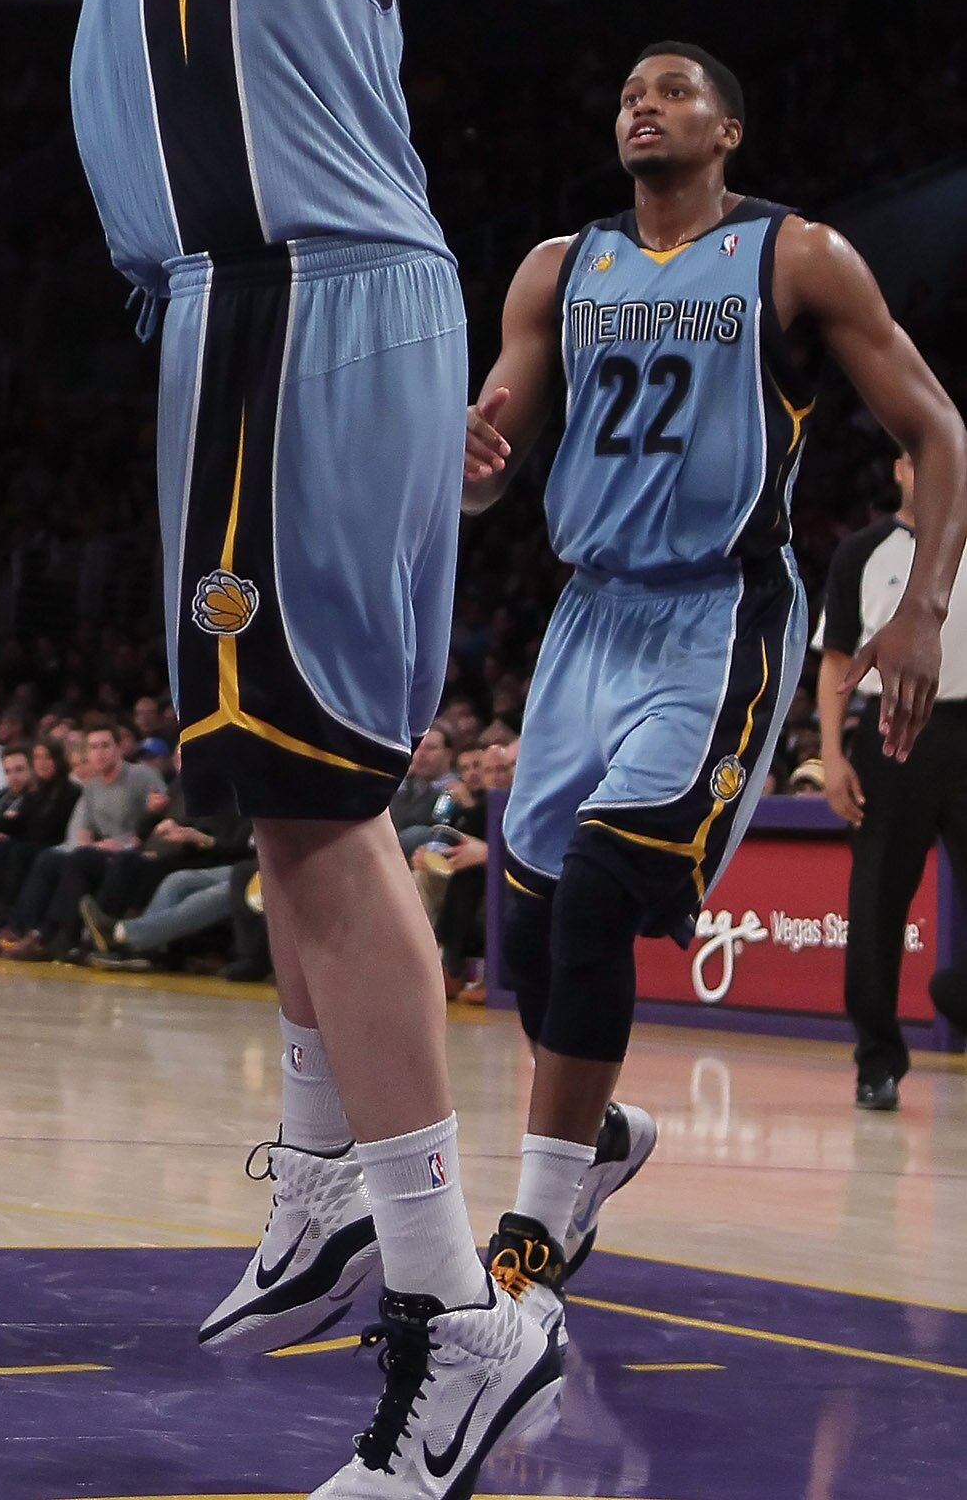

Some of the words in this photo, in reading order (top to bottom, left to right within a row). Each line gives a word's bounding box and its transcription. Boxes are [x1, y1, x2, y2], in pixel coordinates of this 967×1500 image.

[569, 294, 747, 350] MEMPHIS
[594, 354, 692, 456] 22
[769, 910, 823, 953] Vegas
